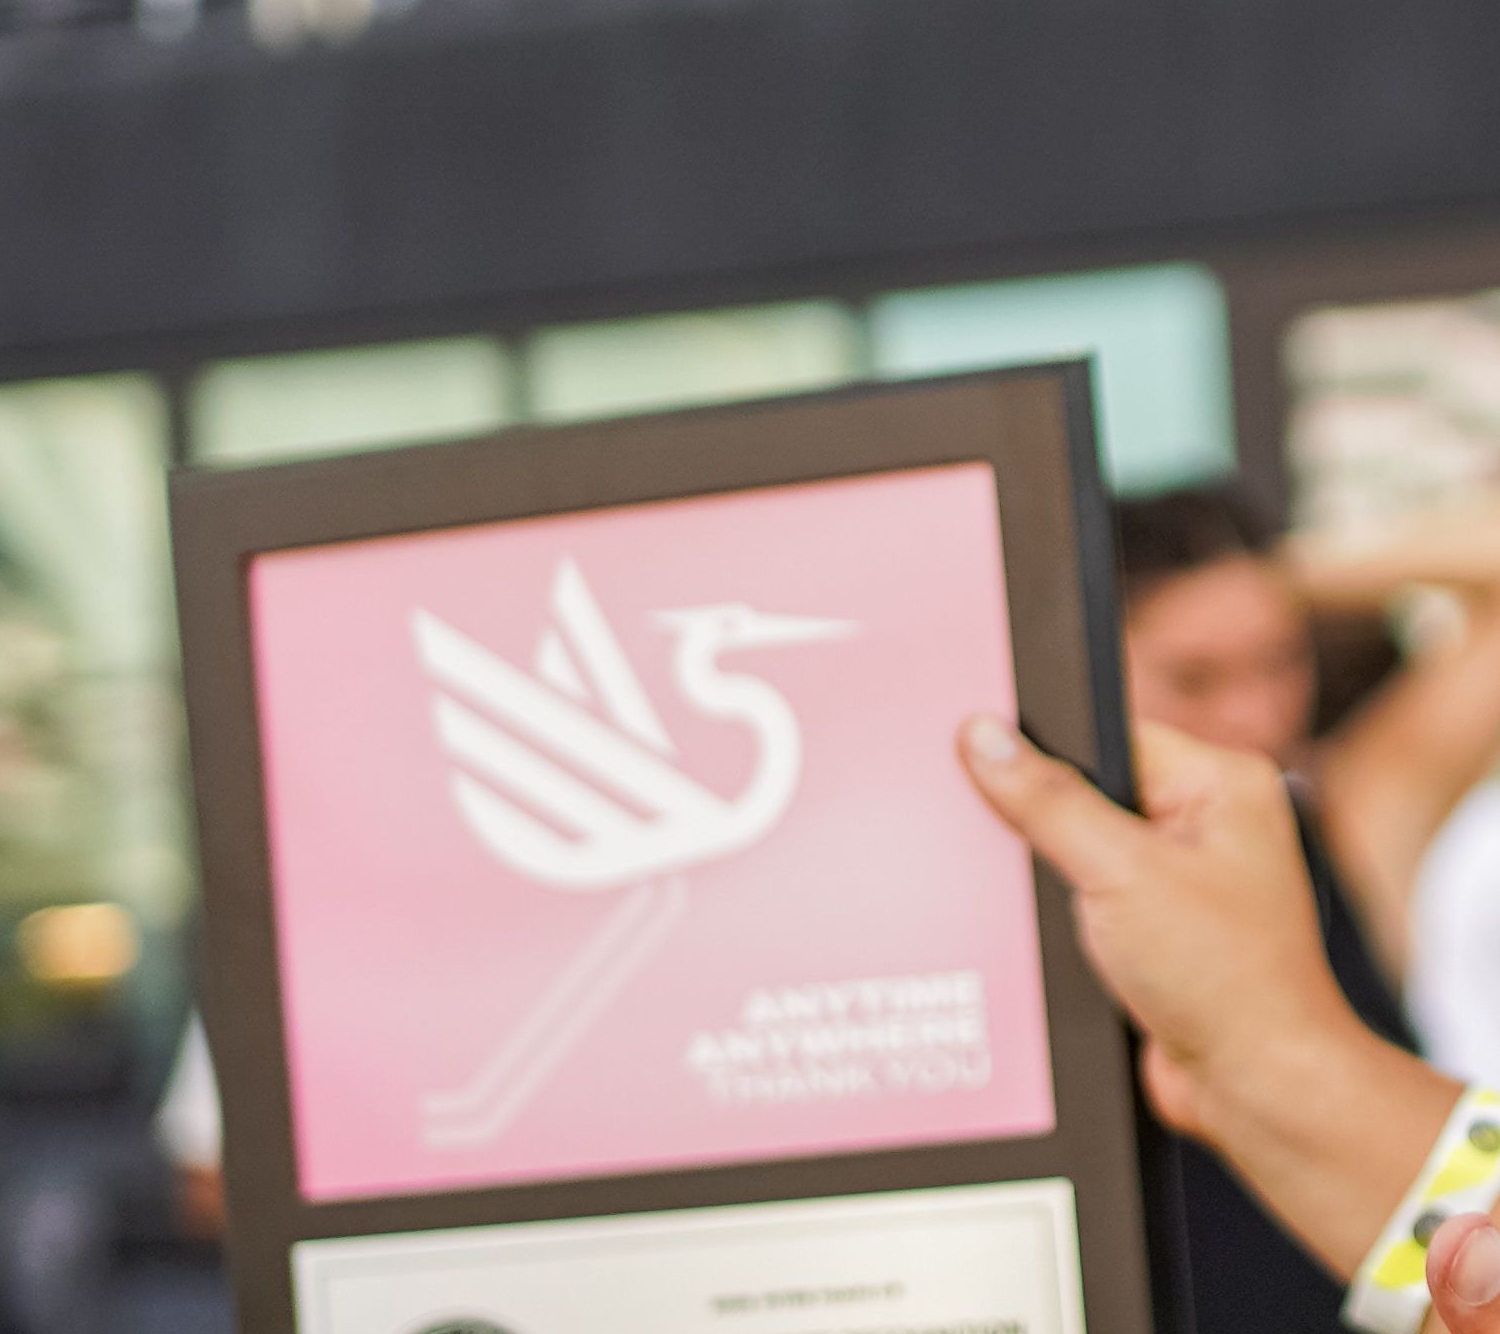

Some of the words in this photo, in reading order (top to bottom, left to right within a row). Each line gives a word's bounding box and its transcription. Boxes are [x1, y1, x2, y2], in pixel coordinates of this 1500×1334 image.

[742, 970, 985, 1021] ANYTIME
[682, 1017, 987, 1071] ANYWHERE
[884, 1046, 992, 1096] YOU
